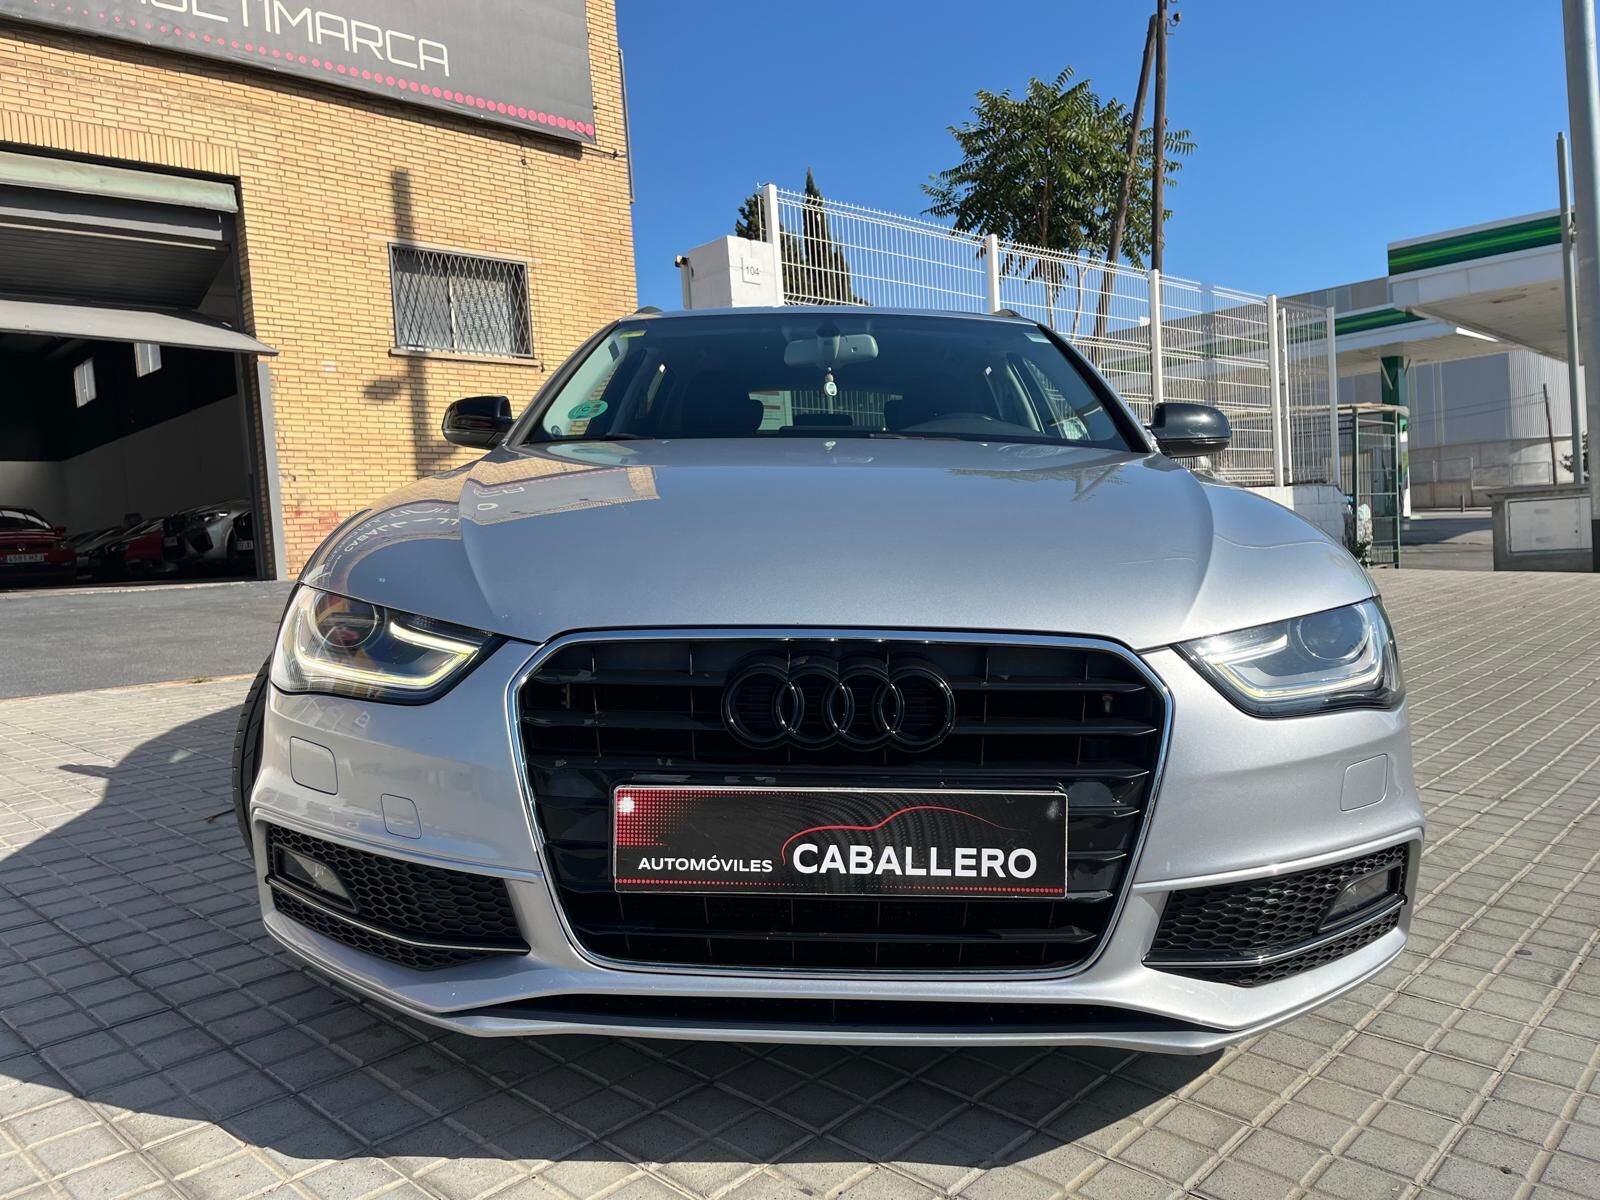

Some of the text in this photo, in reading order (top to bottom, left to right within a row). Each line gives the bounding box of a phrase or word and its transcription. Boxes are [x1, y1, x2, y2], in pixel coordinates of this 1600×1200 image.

[141, 0, 449, 77] LTIMARCA
[746, 266, 760, 276] 104
[638, 843, 1038, 879] AUTOMÓVILES CABALLERO
